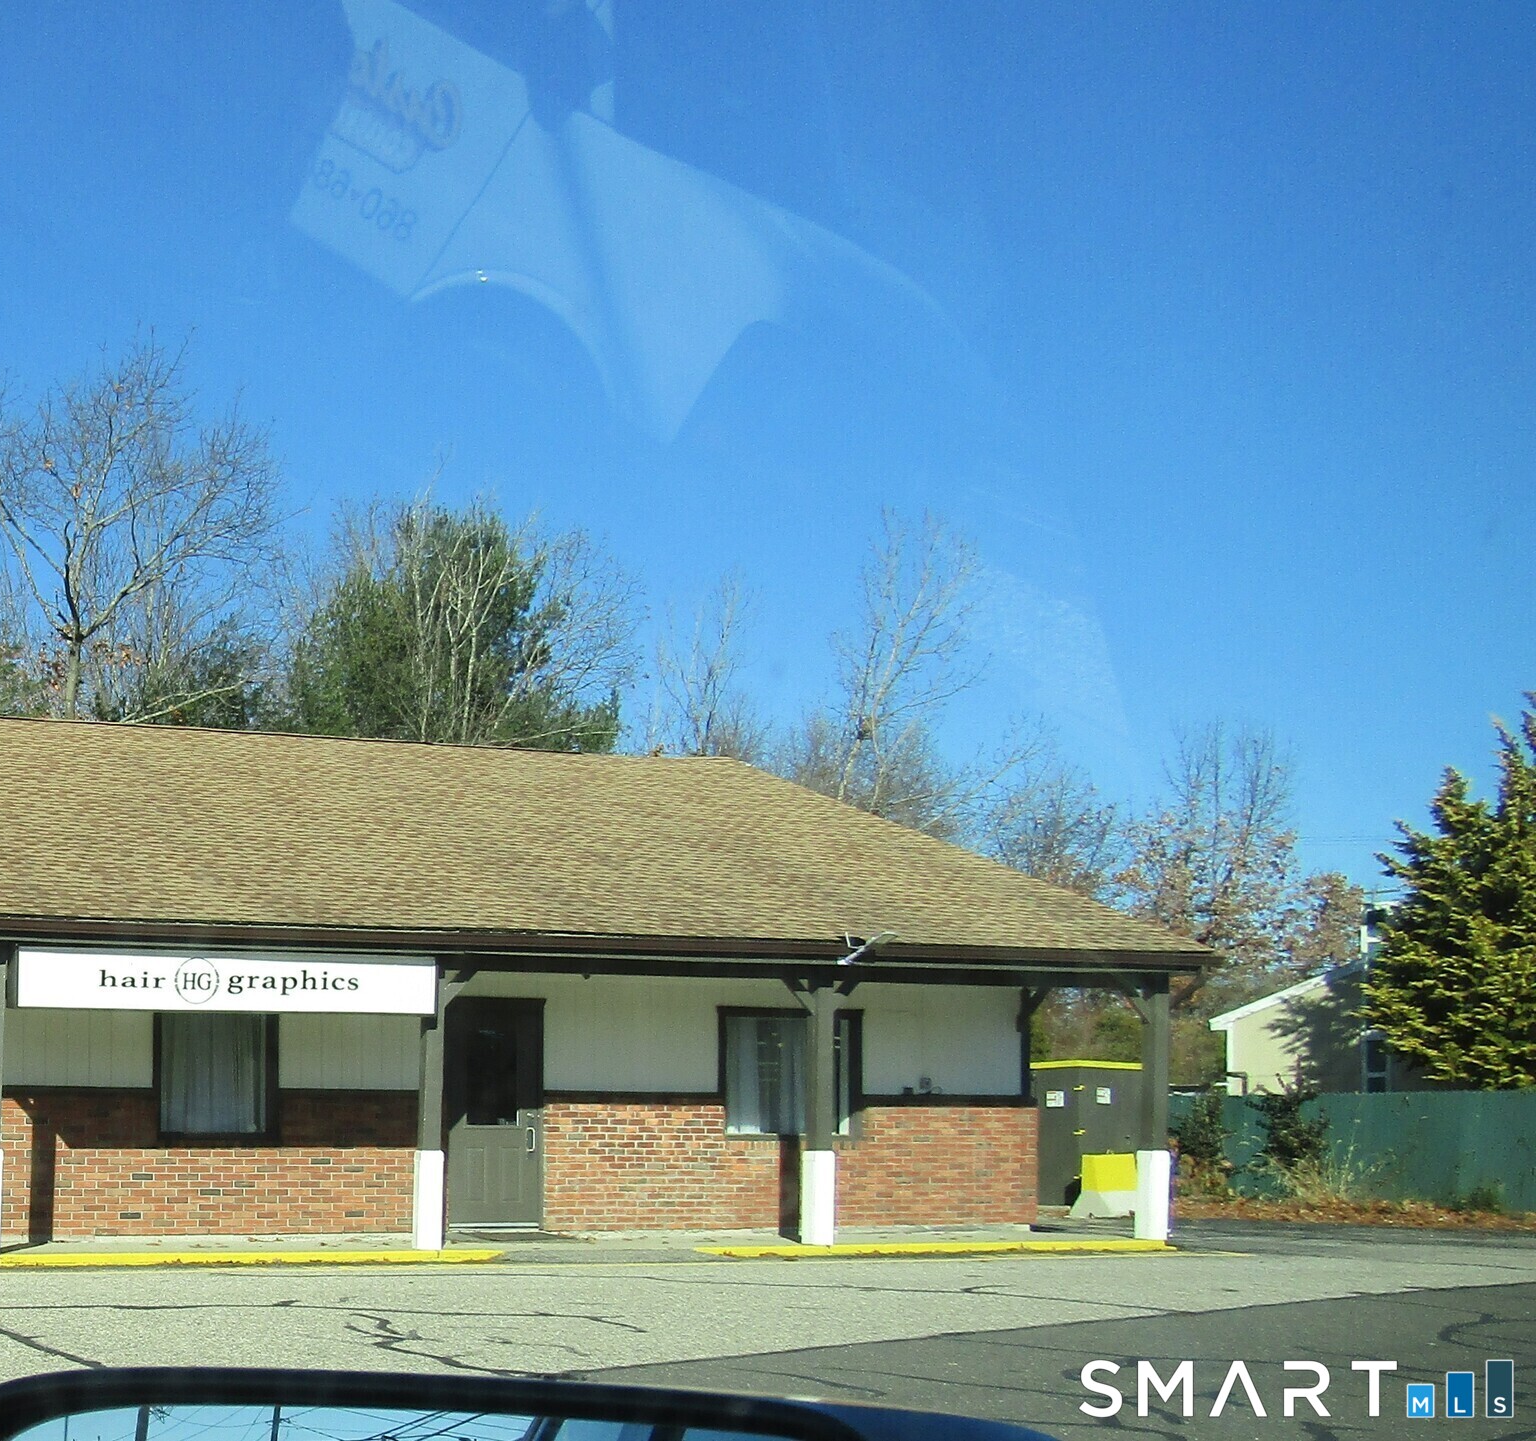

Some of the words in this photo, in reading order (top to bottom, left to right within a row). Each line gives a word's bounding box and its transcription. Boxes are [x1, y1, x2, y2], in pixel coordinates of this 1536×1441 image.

[98, 969, 166, 989] hair
[182, 972, 212, 991] HG
[227, 970, 359, 996] graphics
